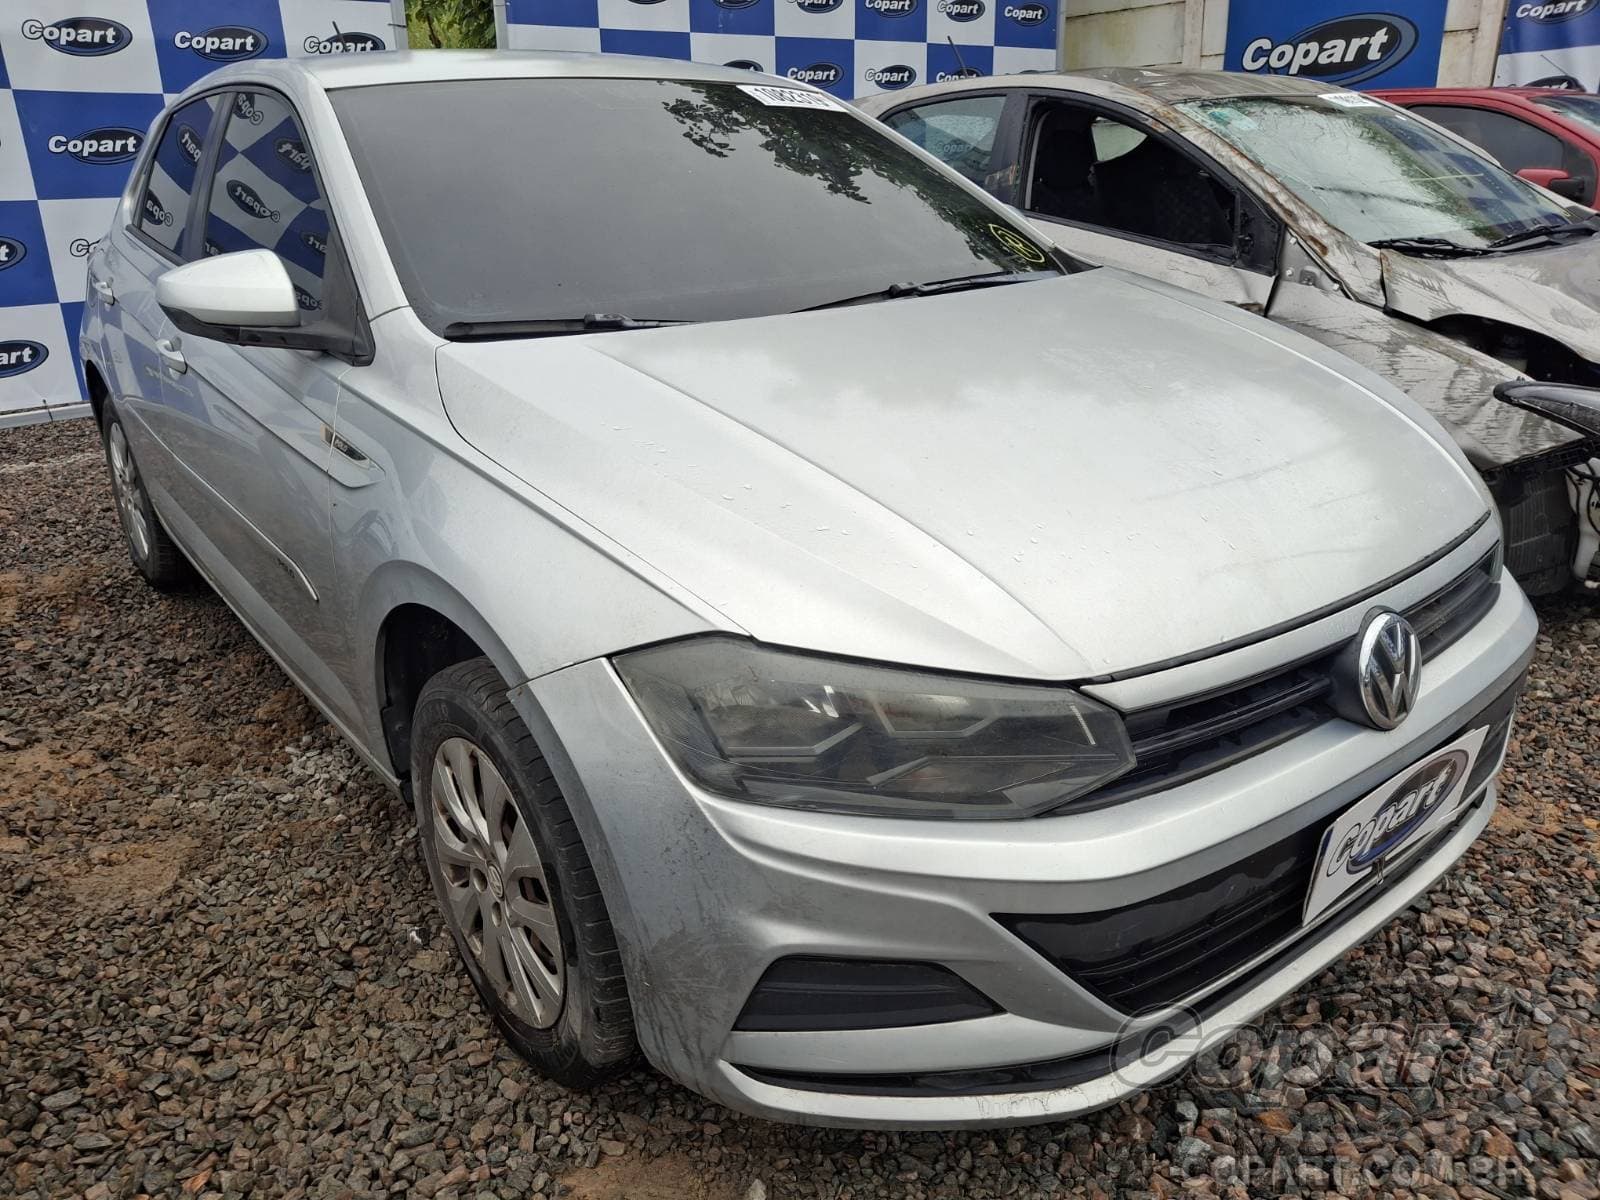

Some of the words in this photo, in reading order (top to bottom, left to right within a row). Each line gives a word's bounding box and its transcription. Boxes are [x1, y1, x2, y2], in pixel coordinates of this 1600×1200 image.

[864, 0, 910, 12] Copart
[937, 1, 979, 15] Copart
[1004, 6, 1043, 20] Copart
[1515, 0, 1586, 19] Copart
[22, 19, 116, 44] Copart
[174, 31, 255, 51] Copart
[1242, 27, 1389, 75] Copart
[787, 68, 836, 83] Copart
[865, 69, 909, 83] Copart
[49, 134, 138, 156] Copart
[0, 347, 32, 365] art
[1326, 758, 1456, 877] Copart
